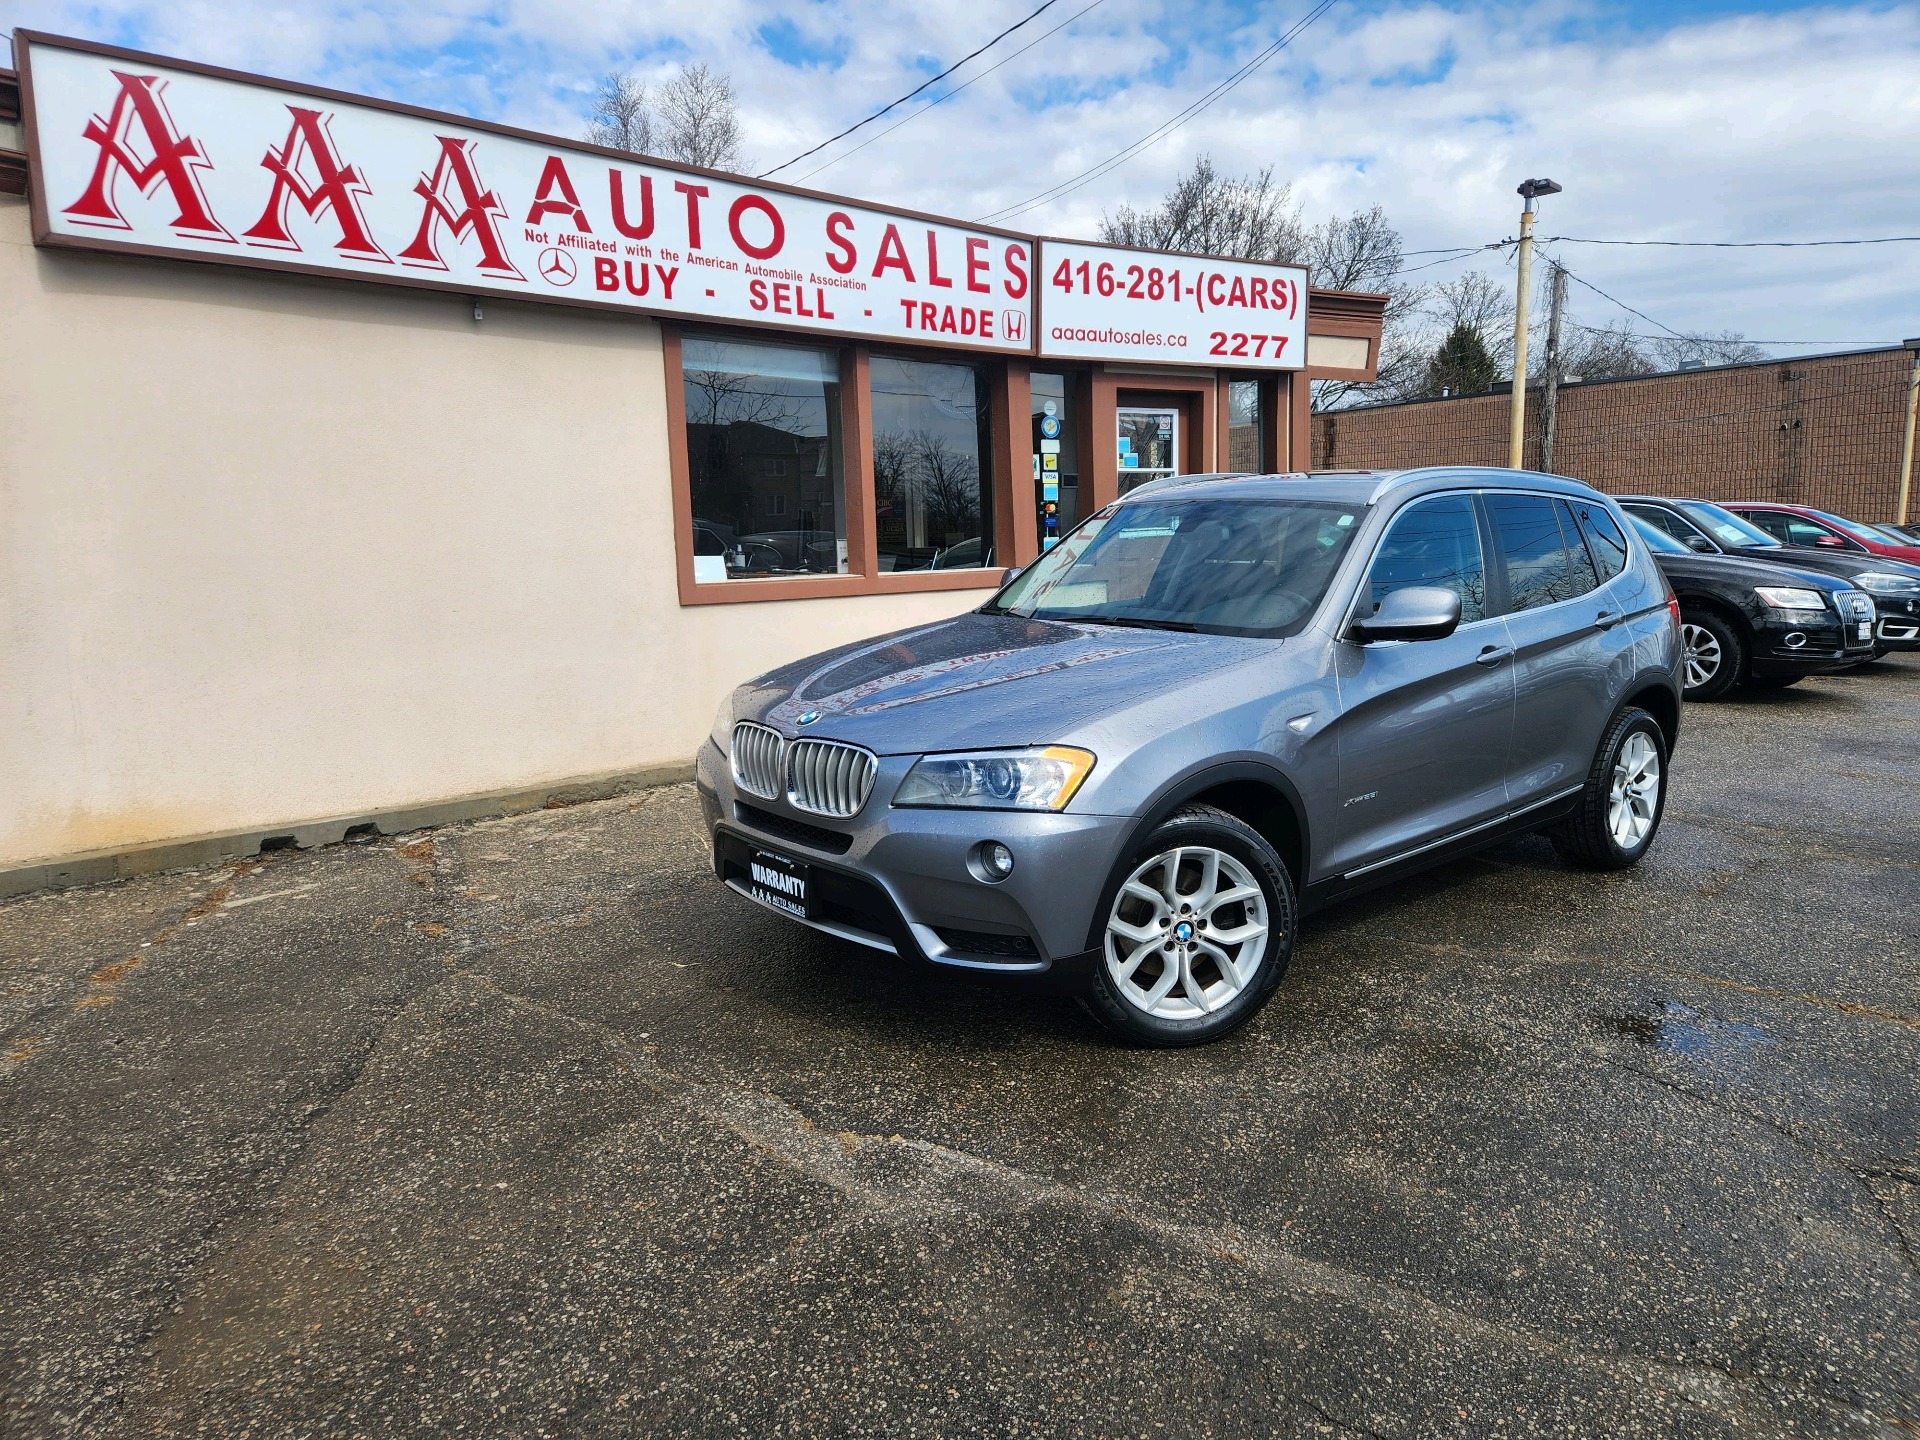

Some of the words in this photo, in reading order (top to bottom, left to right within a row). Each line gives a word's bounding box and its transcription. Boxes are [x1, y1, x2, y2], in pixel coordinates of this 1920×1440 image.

[526, 156, 785, 260] AUTO
[825, 211, 1028, 300] SALES
[524, 228, 549, 244] Not
[557, 233, 616, 253] Affiliated
[624, 245, 651, 258] with
[660, 248, 679, 262] the
[687, 252, 738, 271] American
[745, 262, 803, 282] Automobile
[809, 272, 867, 291] Association
[594, 256, 680, 300] BUY
[749, 279, 835, 320] SELL
[900, 300, 994, 338] TRADE
[1052, 258, 1297, 320] 416-281-(CARS)
[1051, 326, 1188, 347] aaaautosales.ca
[1209, 331, 1289, 359] 2277
[876, 498, 893, 507] CIBC
[751, 862, 805, 899] WARRANTY
[772, 895, 787, 907] AUTO
[787, 901, 806, 915] SALES
